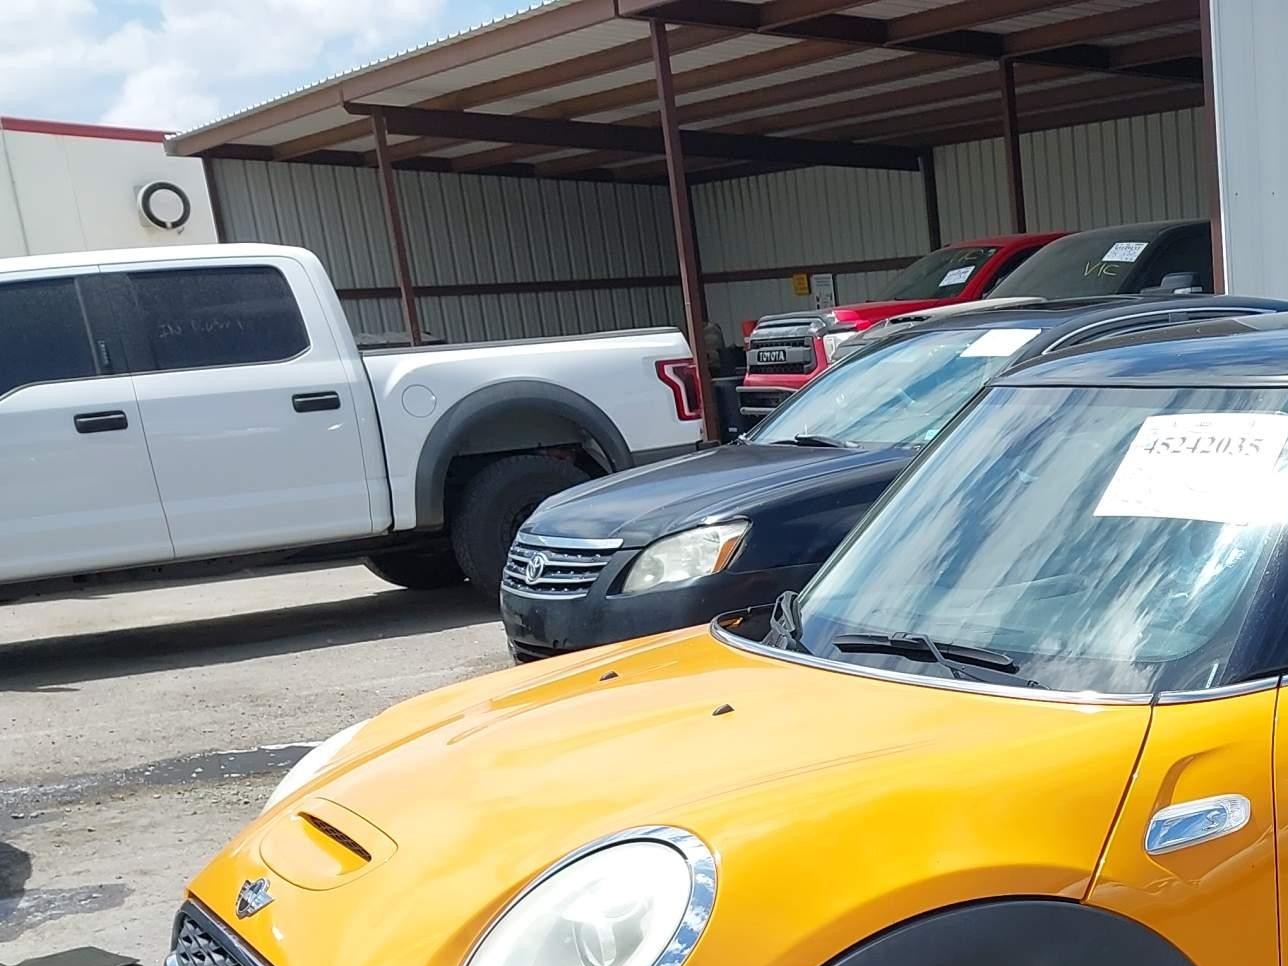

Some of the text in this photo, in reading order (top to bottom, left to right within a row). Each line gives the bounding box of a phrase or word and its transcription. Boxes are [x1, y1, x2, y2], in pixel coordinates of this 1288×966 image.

[1084, 262, 1120, 276] VIC
[759, 351, 785, 361] TOYOTA
[1144, 436, 1265, 456] 45242035
